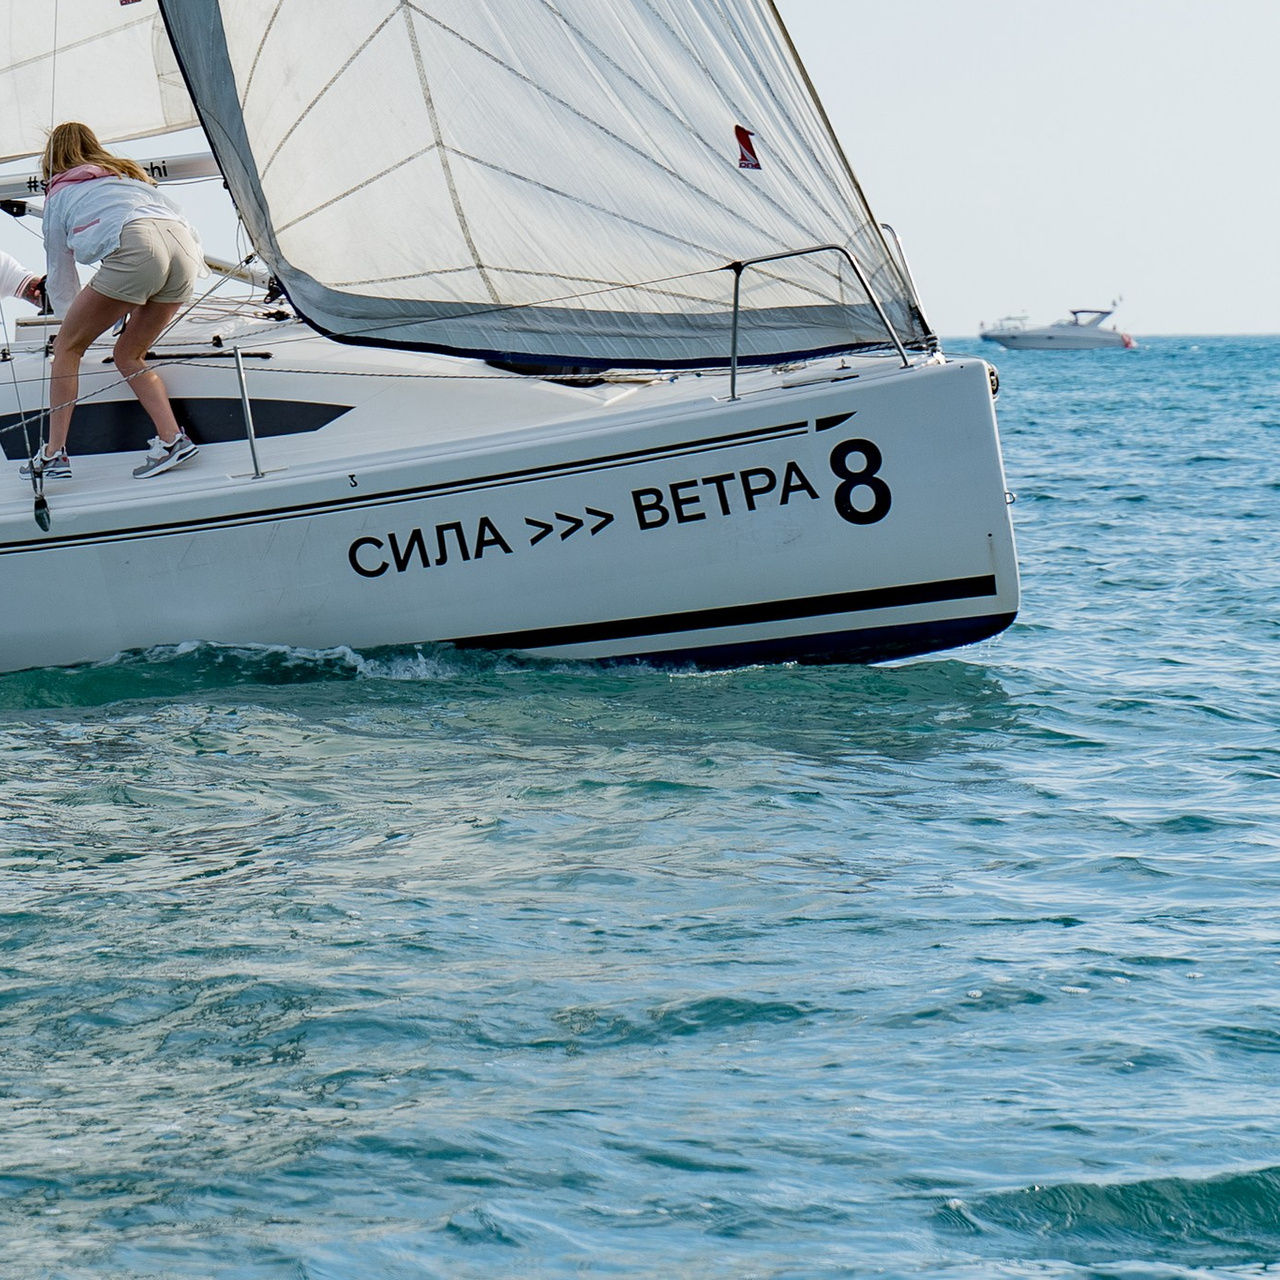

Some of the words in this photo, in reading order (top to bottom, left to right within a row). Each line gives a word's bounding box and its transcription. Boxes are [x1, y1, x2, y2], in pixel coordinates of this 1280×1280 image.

[348, 516, 513, 579] СИЛА
[631, 461, 820, 531] ВЕТРА
[829, 438, 892, 525] 8
